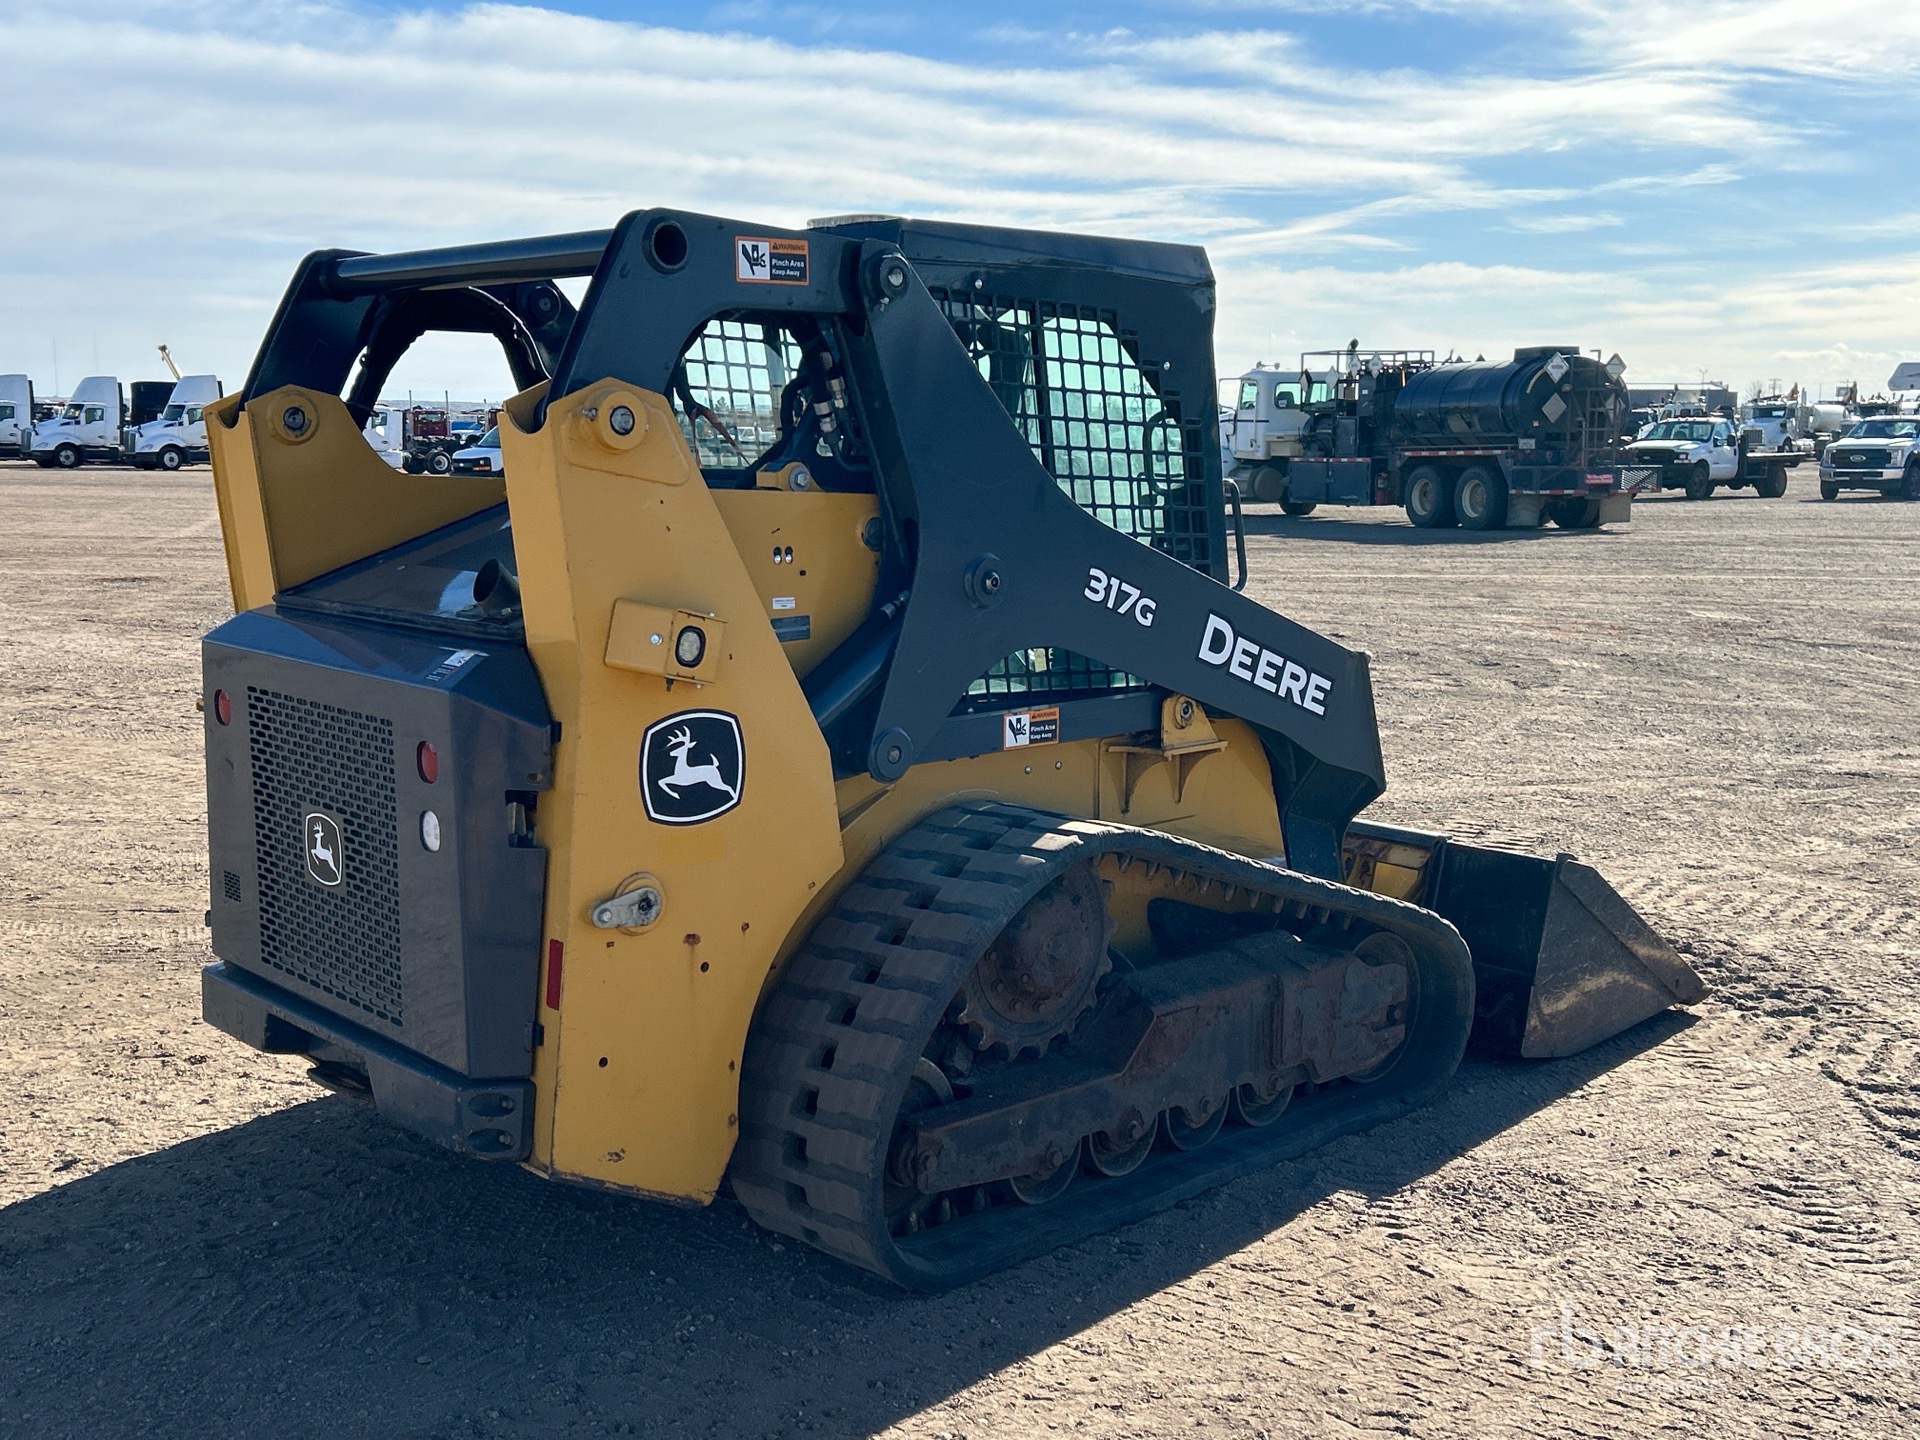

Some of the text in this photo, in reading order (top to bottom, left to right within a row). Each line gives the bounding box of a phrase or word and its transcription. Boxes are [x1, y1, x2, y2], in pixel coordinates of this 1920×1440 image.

[778, 243, 805, 251] WARNING
[771, 258, 805, 268] Pinch Area
[772, 268, 800, 278] Keep Away
[1084, 568, 1157, 627] 317G
[1198, 613, 1332, 716] DEERE
